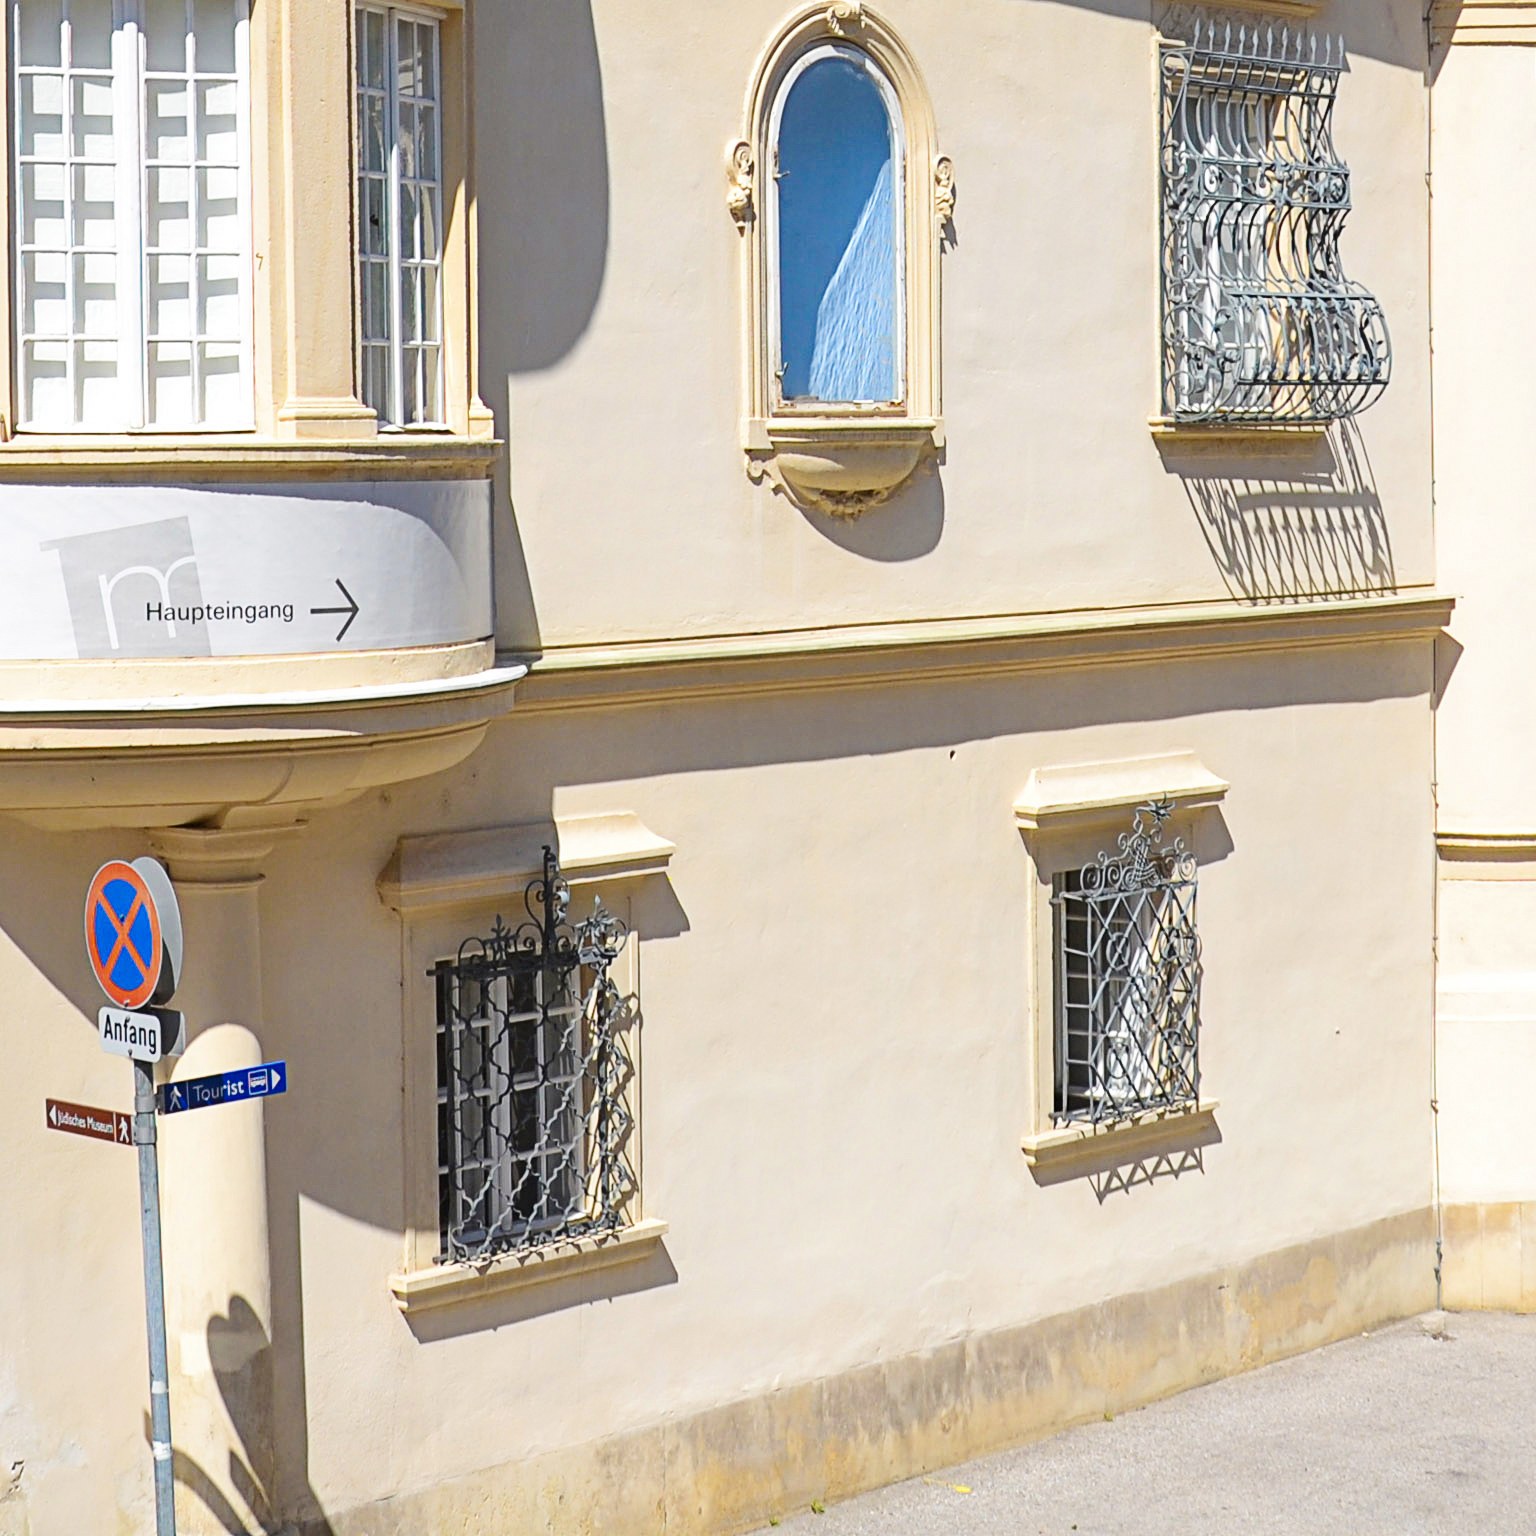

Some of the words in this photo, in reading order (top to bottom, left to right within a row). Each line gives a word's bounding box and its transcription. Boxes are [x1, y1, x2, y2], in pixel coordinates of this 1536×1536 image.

[145, 600, 295, 625] Haupteingang
[104, 1014, 157, 1055] Anfang
[192, 1079, 245, 1102] Tourist
[87, 1115, 114, 1134] Museum
